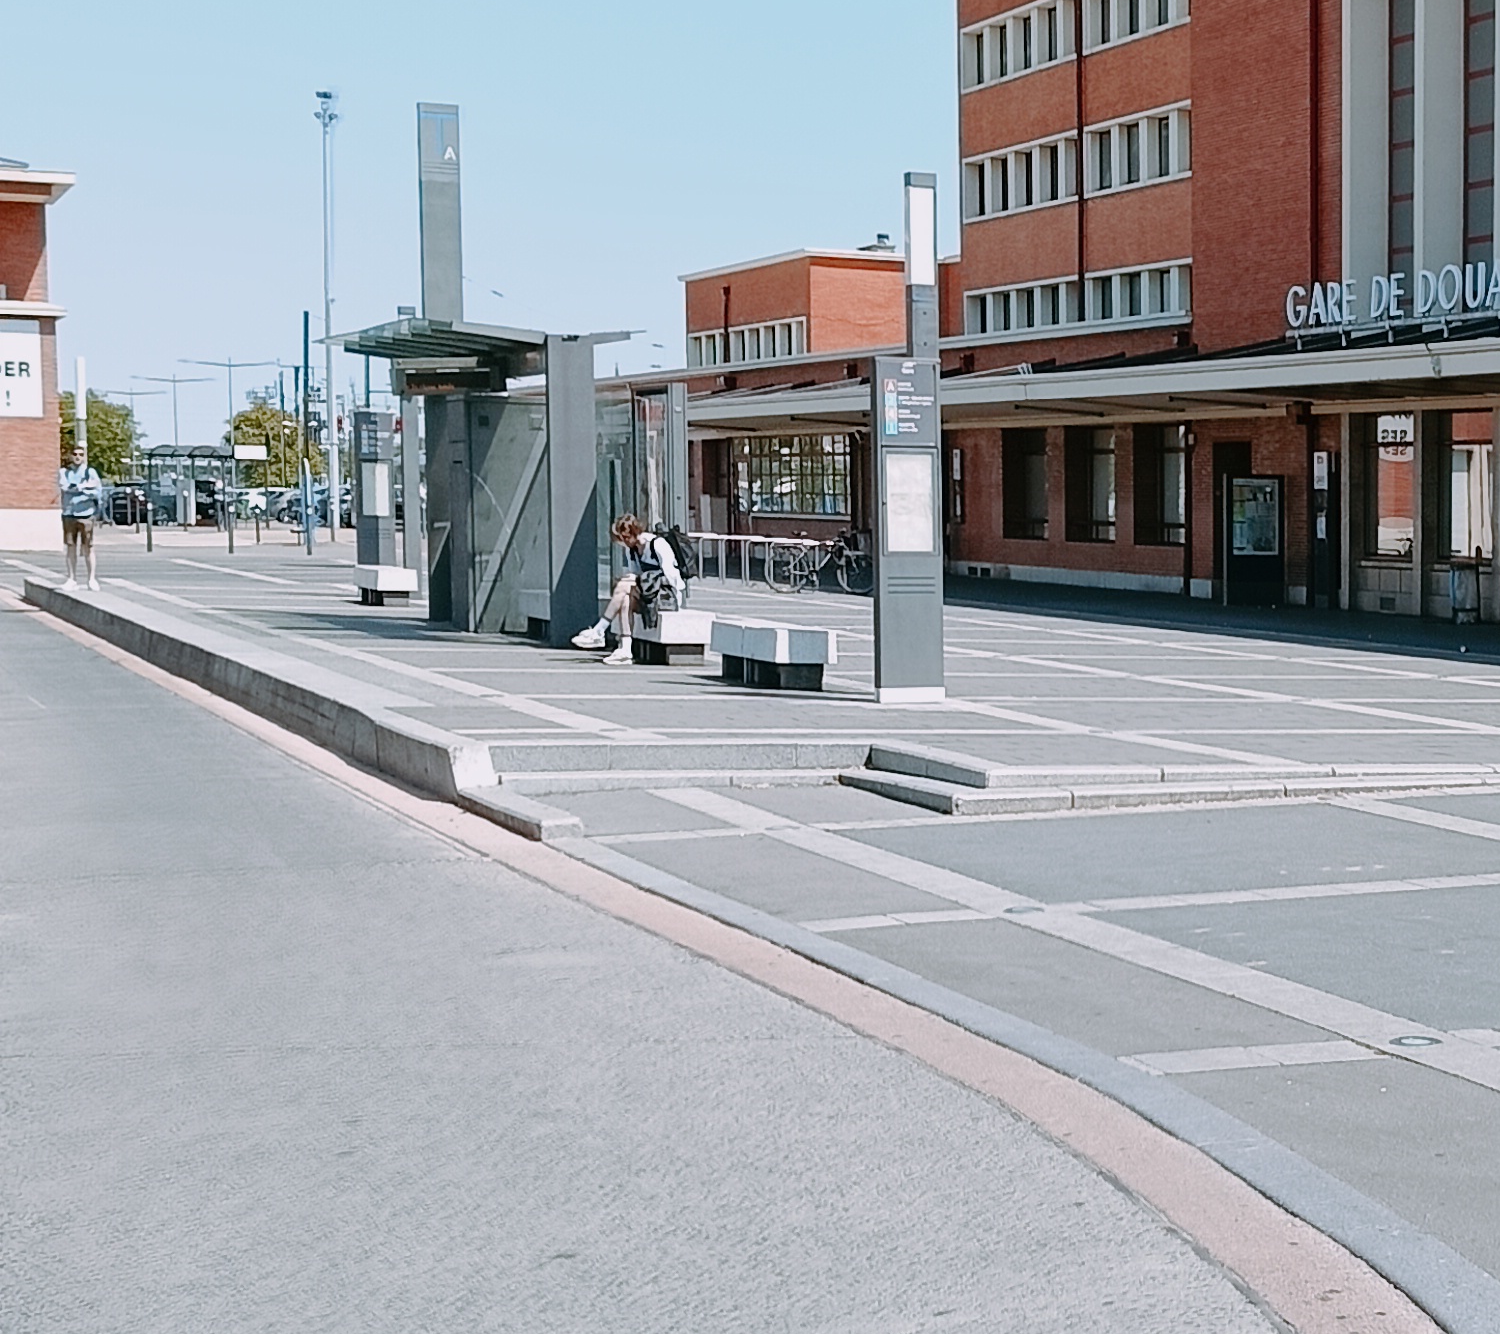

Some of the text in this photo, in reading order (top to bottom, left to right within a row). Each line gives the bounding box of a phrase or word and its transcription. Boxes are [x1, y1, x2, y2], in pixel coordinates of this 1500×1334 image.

[444, 146, 456, 160] A
[1286, 279, 1357, 328] GARE
[1370, 272, 1405, 318] DE
[0, 361, 31, 378] ER
